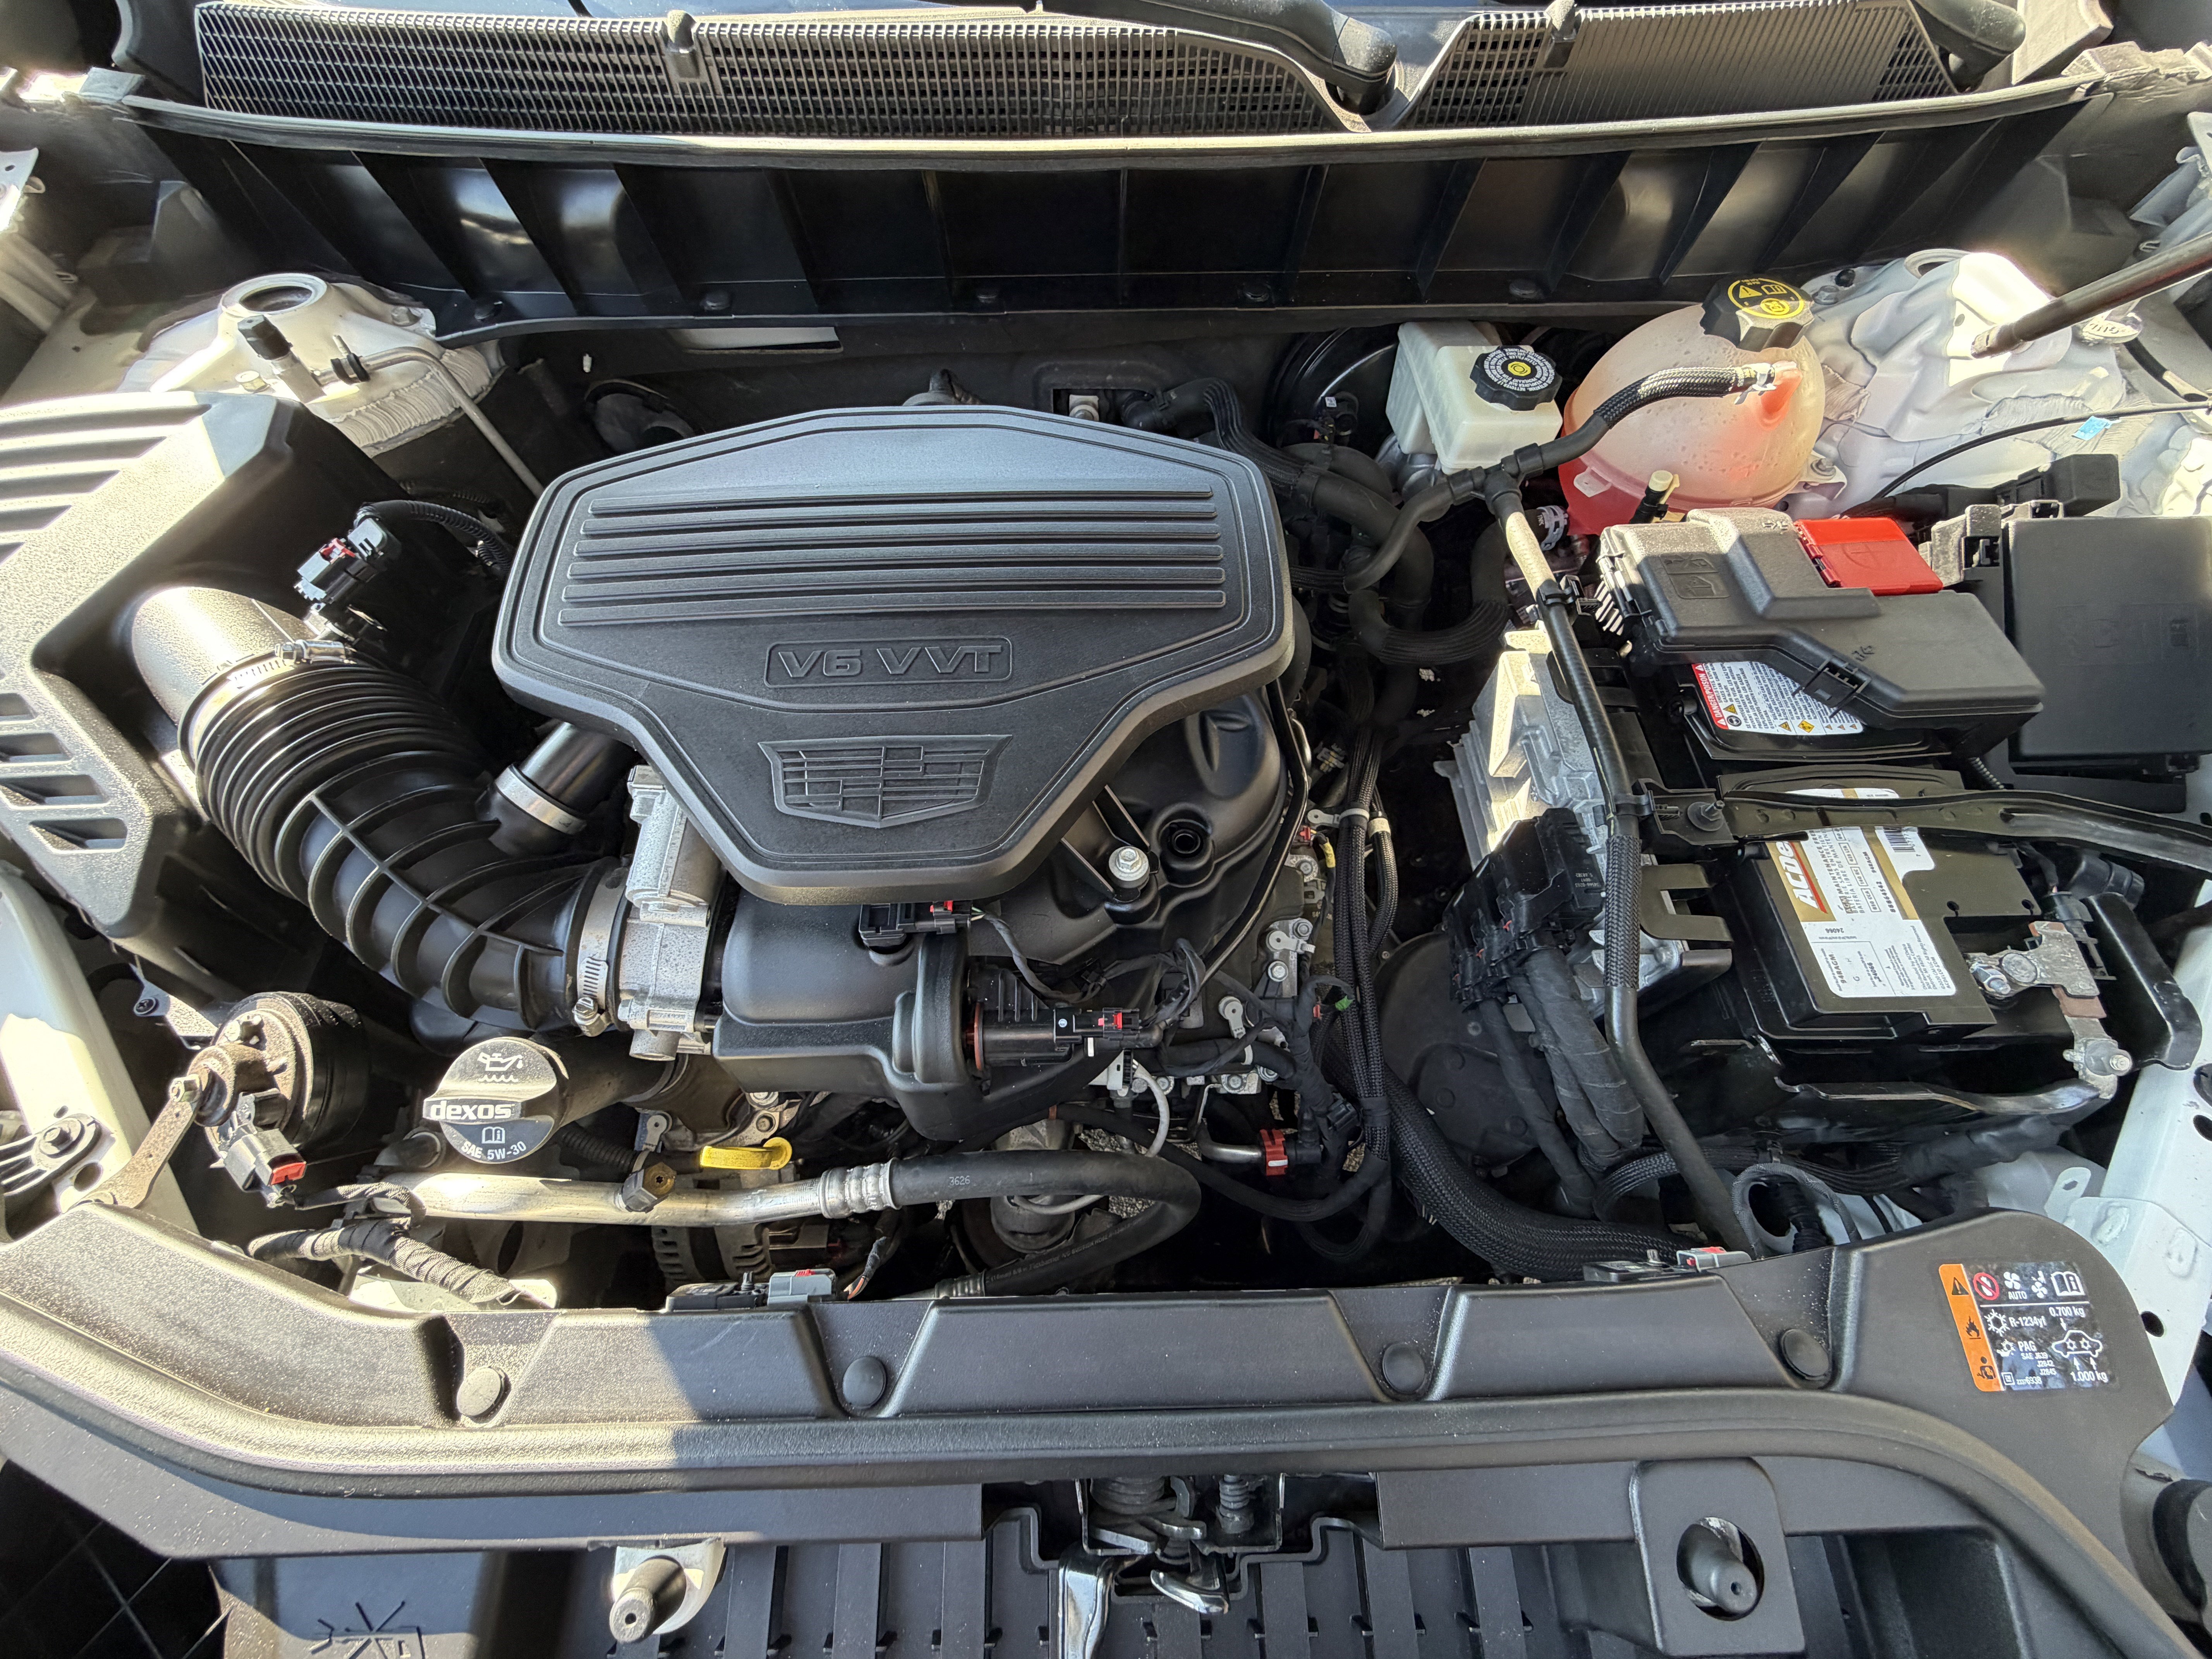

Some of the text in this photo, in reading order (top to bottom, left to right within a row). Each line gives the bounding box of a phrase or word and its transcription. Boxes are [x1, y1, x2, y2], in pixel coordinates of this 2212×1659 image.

[778, 645, 1002, 678] V6 VVT
[1698, 673, 1723, 718] DANGER/POISON
[1815, 846, 1844, 894] MAINTENANCE
[1862, 851, 1877, 873] 94RAGM
[1776, 841, 1819, 909] ACDe
[1816, 835, 1859, 913] BATTERIE SANS ENTRETIEN
[1840, 870, 1852, 886] LIBRE
[1848, 888, 1865, 913] BATERÍA
[1864, 891, 1873, 899] CCA
[1875, 881, 1896, 912] 88864542
[1840, 896, 1854, 913] AGM
[1910, 926, 1922, 942] Reserved
[1900, 944, 1913, 960] ACDelco
[1905, 943, 1916, 956] Center
[1827, 954, 1848, 983] 94RAGM
[1866, 962, 1881, 979] 24066
[430, 1100, 513, 1120] dexos
[461, 1141, 526, 1160] SAE 5W-30
[949, 1175, 970, 1185] 3626
[2008, 1291, 2027, 1300] AUTO
[2049, 1306, 2085, 1317] 0.700 kg
[2009, 1316, 2047, 1328] R-1234yf
[2018, 1341, 2037, 1352] PAG
[2071, 1371, 2109, 1383] 1.000 kg
